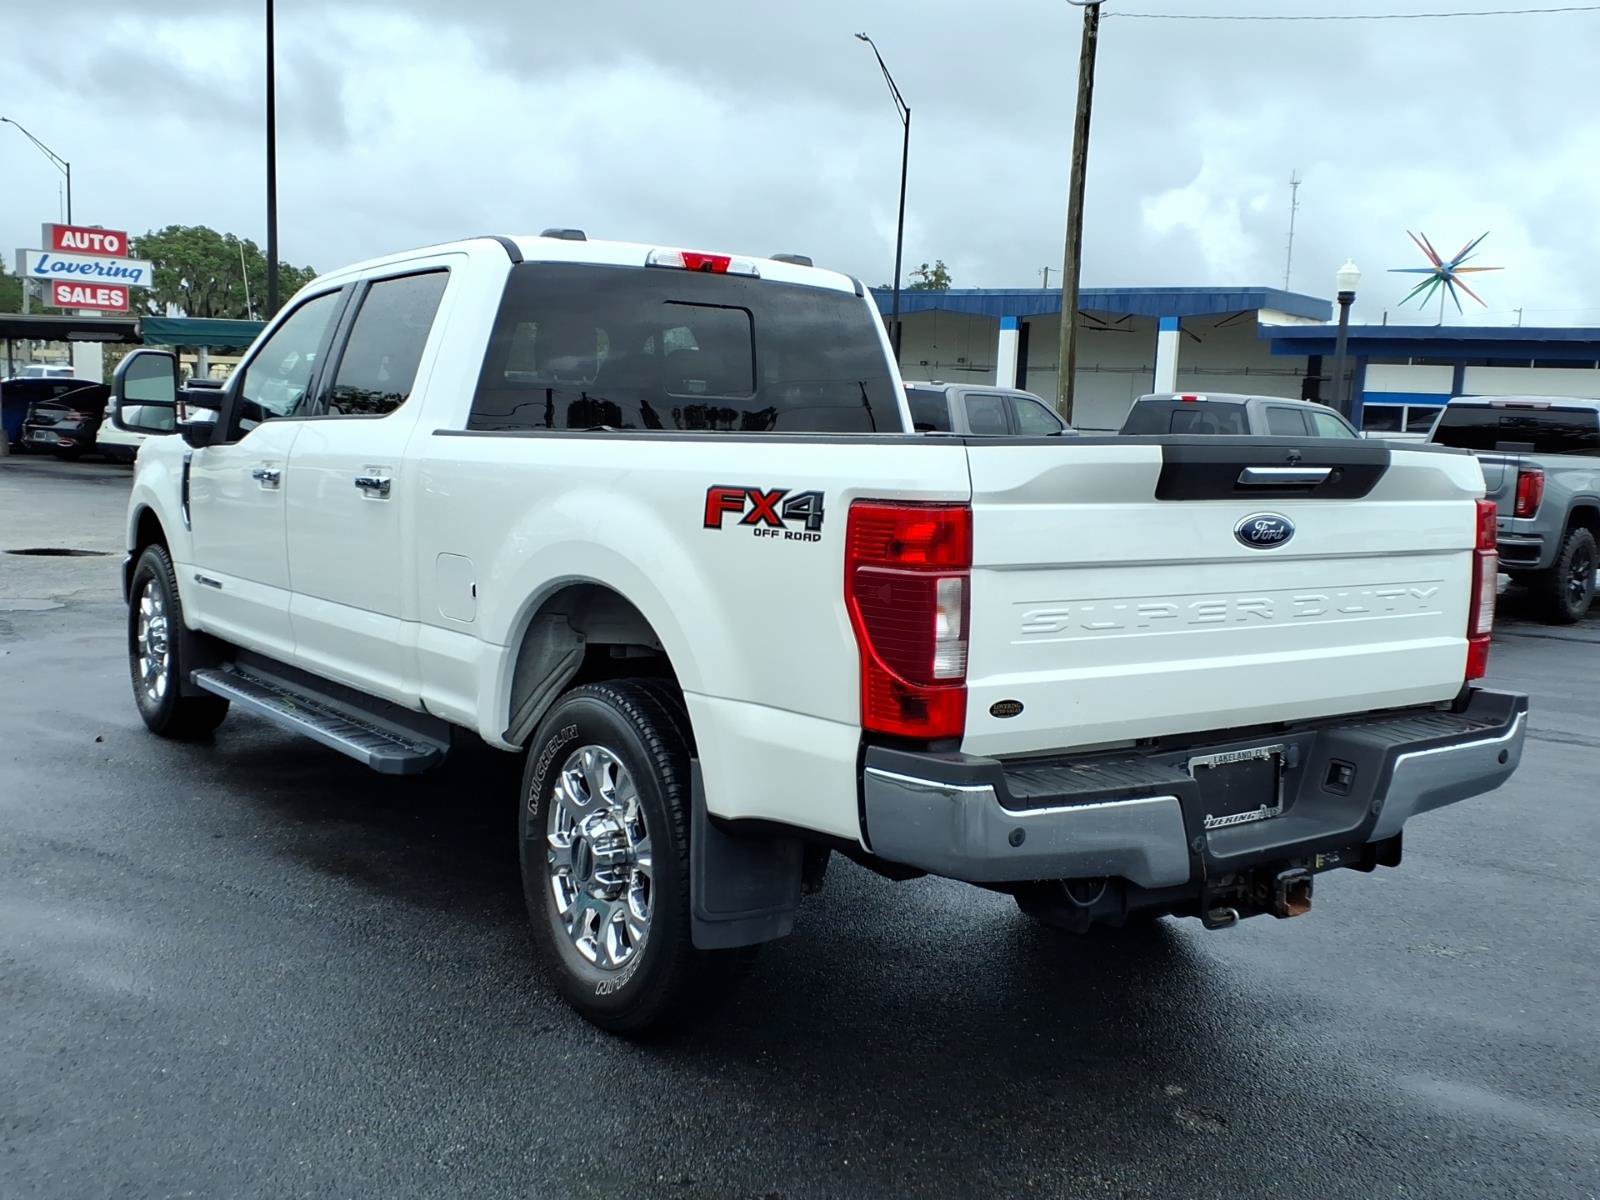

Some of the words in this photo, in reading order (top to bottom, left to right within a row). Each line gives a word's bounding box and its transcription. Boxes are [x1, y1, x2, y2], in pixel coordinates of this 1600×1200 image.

[61, 231, 120, 252] AUTO
[34, 254, 144, 283] Lovering
[57, 285, 124, 306] SALES
[703, 484, 825, 532] FX4
[753, 528, 780, 539] OFF
[784, 531, 822, 542] ROAD
[1251, 520, 1285, 540] Ford
[1021, 598, 1274, 635] SUPER
[1292, 586, 1439, 618] DUTY
[1213, 750, 1252, 763] LAKELAND
[528, 723, 579, 815] MICHELIN
